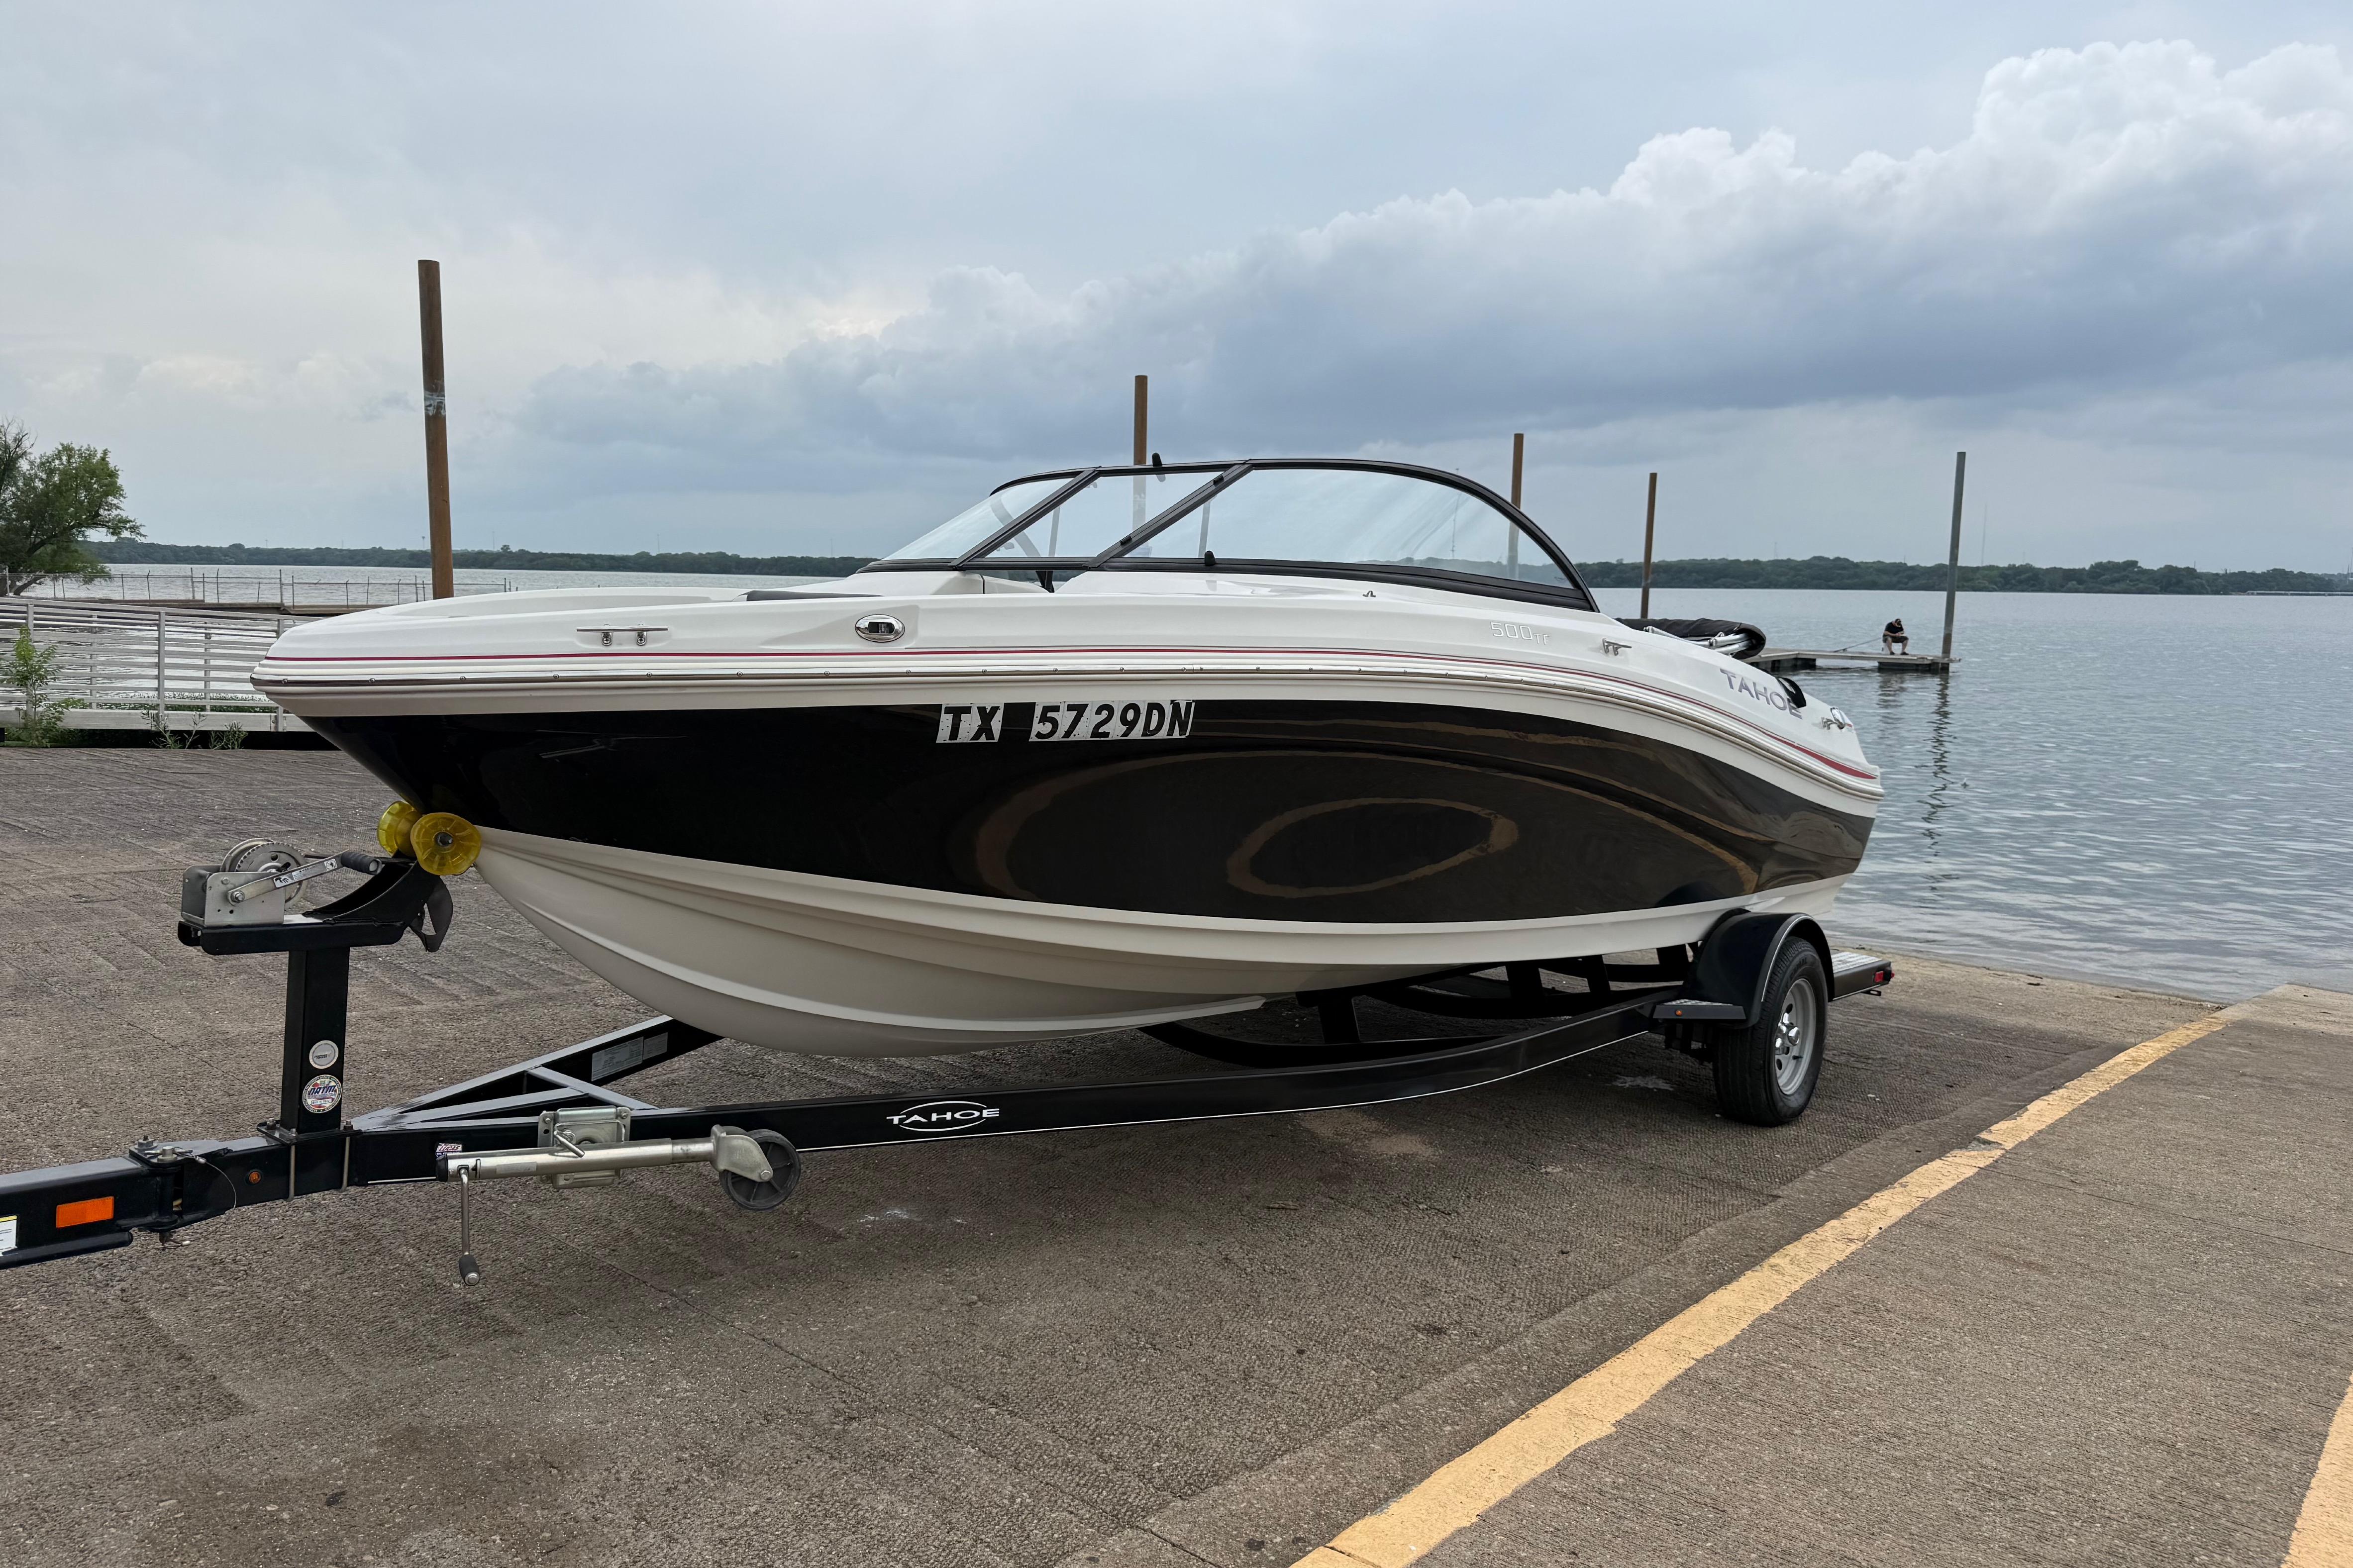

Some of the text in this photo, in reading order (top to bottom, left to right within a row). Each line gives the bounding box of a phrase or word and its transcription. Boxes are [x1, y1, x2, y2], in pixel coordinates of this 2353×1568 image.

[1720, 668, 1803, 720] TAHOE
[943, 701, 1193, 741] TX 5729DN
[887, 1108, 1000, 1124] TAHOE
